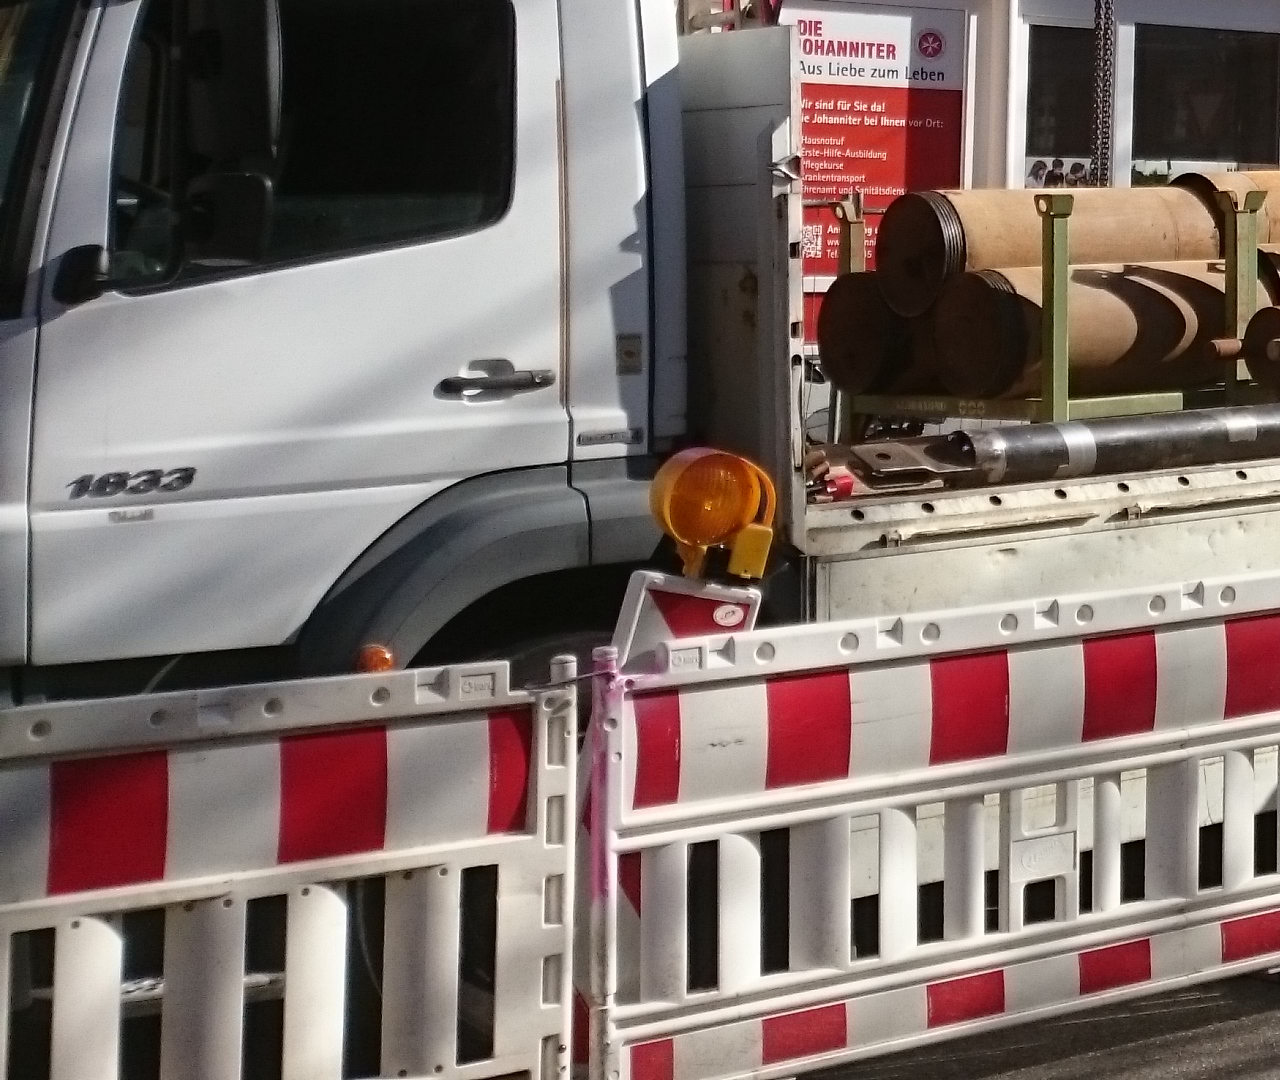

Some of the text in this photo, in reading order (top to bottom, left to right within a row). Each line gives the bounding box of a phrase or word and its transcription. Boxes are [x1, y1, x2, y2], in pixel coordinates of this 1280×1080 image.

[798, 20, 823, 37] DIE
[828, 62, 866, 78] Liebe
[870, 67, 899, 80] zum
[904, 66, 945, 82] Leben
[814, 99, 834, 111] sind
[837, 100, 851, 111] für
[853, 101, 868, 112] Sie
[870, 102, 886, 113] da!
[801, 113, 944, 129] ie Johanniter bei Ihnen vor Ort:
[801, 135, 846, 146] Hausnotruf
[801, 148, 887, 161] Erste-Hilfe-Ausbildung
[855, 185, 907, 196] Sanitätsdiens
